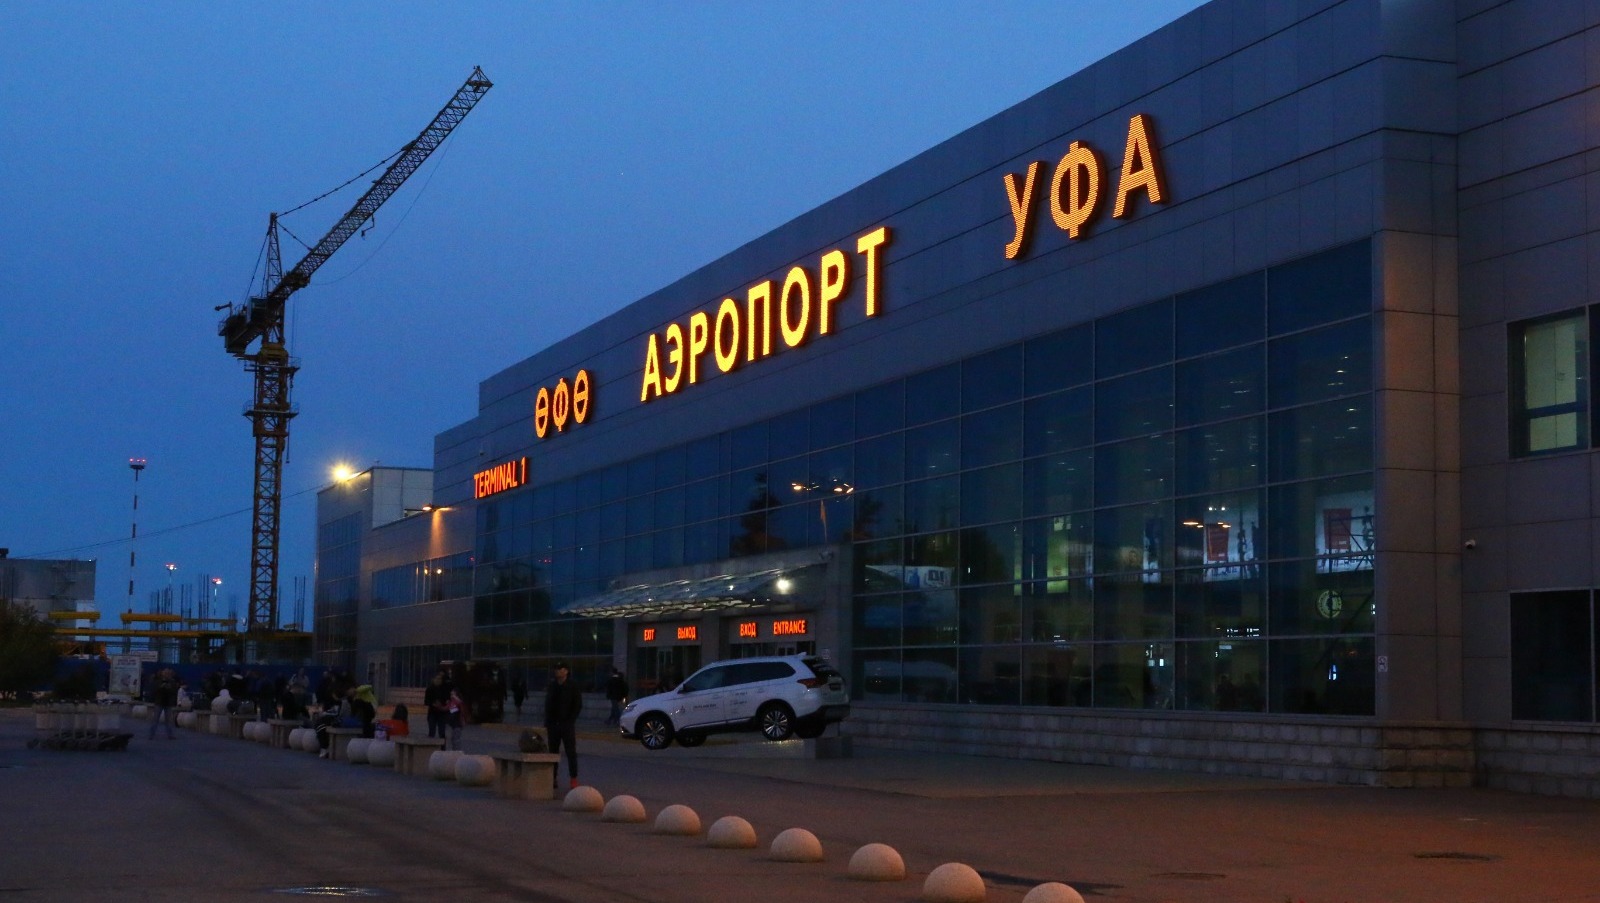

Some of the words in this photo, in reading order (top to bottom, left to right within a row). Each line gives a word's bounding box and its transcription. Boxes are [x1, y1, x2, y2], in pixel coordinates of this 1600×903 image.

[1003, 115, 1163, 260] УФА
[640, 226, 888, 403] АЭРОПОРТ
[473, 460, 518, 499] TERMINAL
[520, 456, 527, 484] 1
[643, 628, 655, 641] EXIT
[677, 626, 697, 640] ВЫХОД
[739, 622, 757, 637] ВХОД
[773, 619, 806, 635] ENTRANCE
